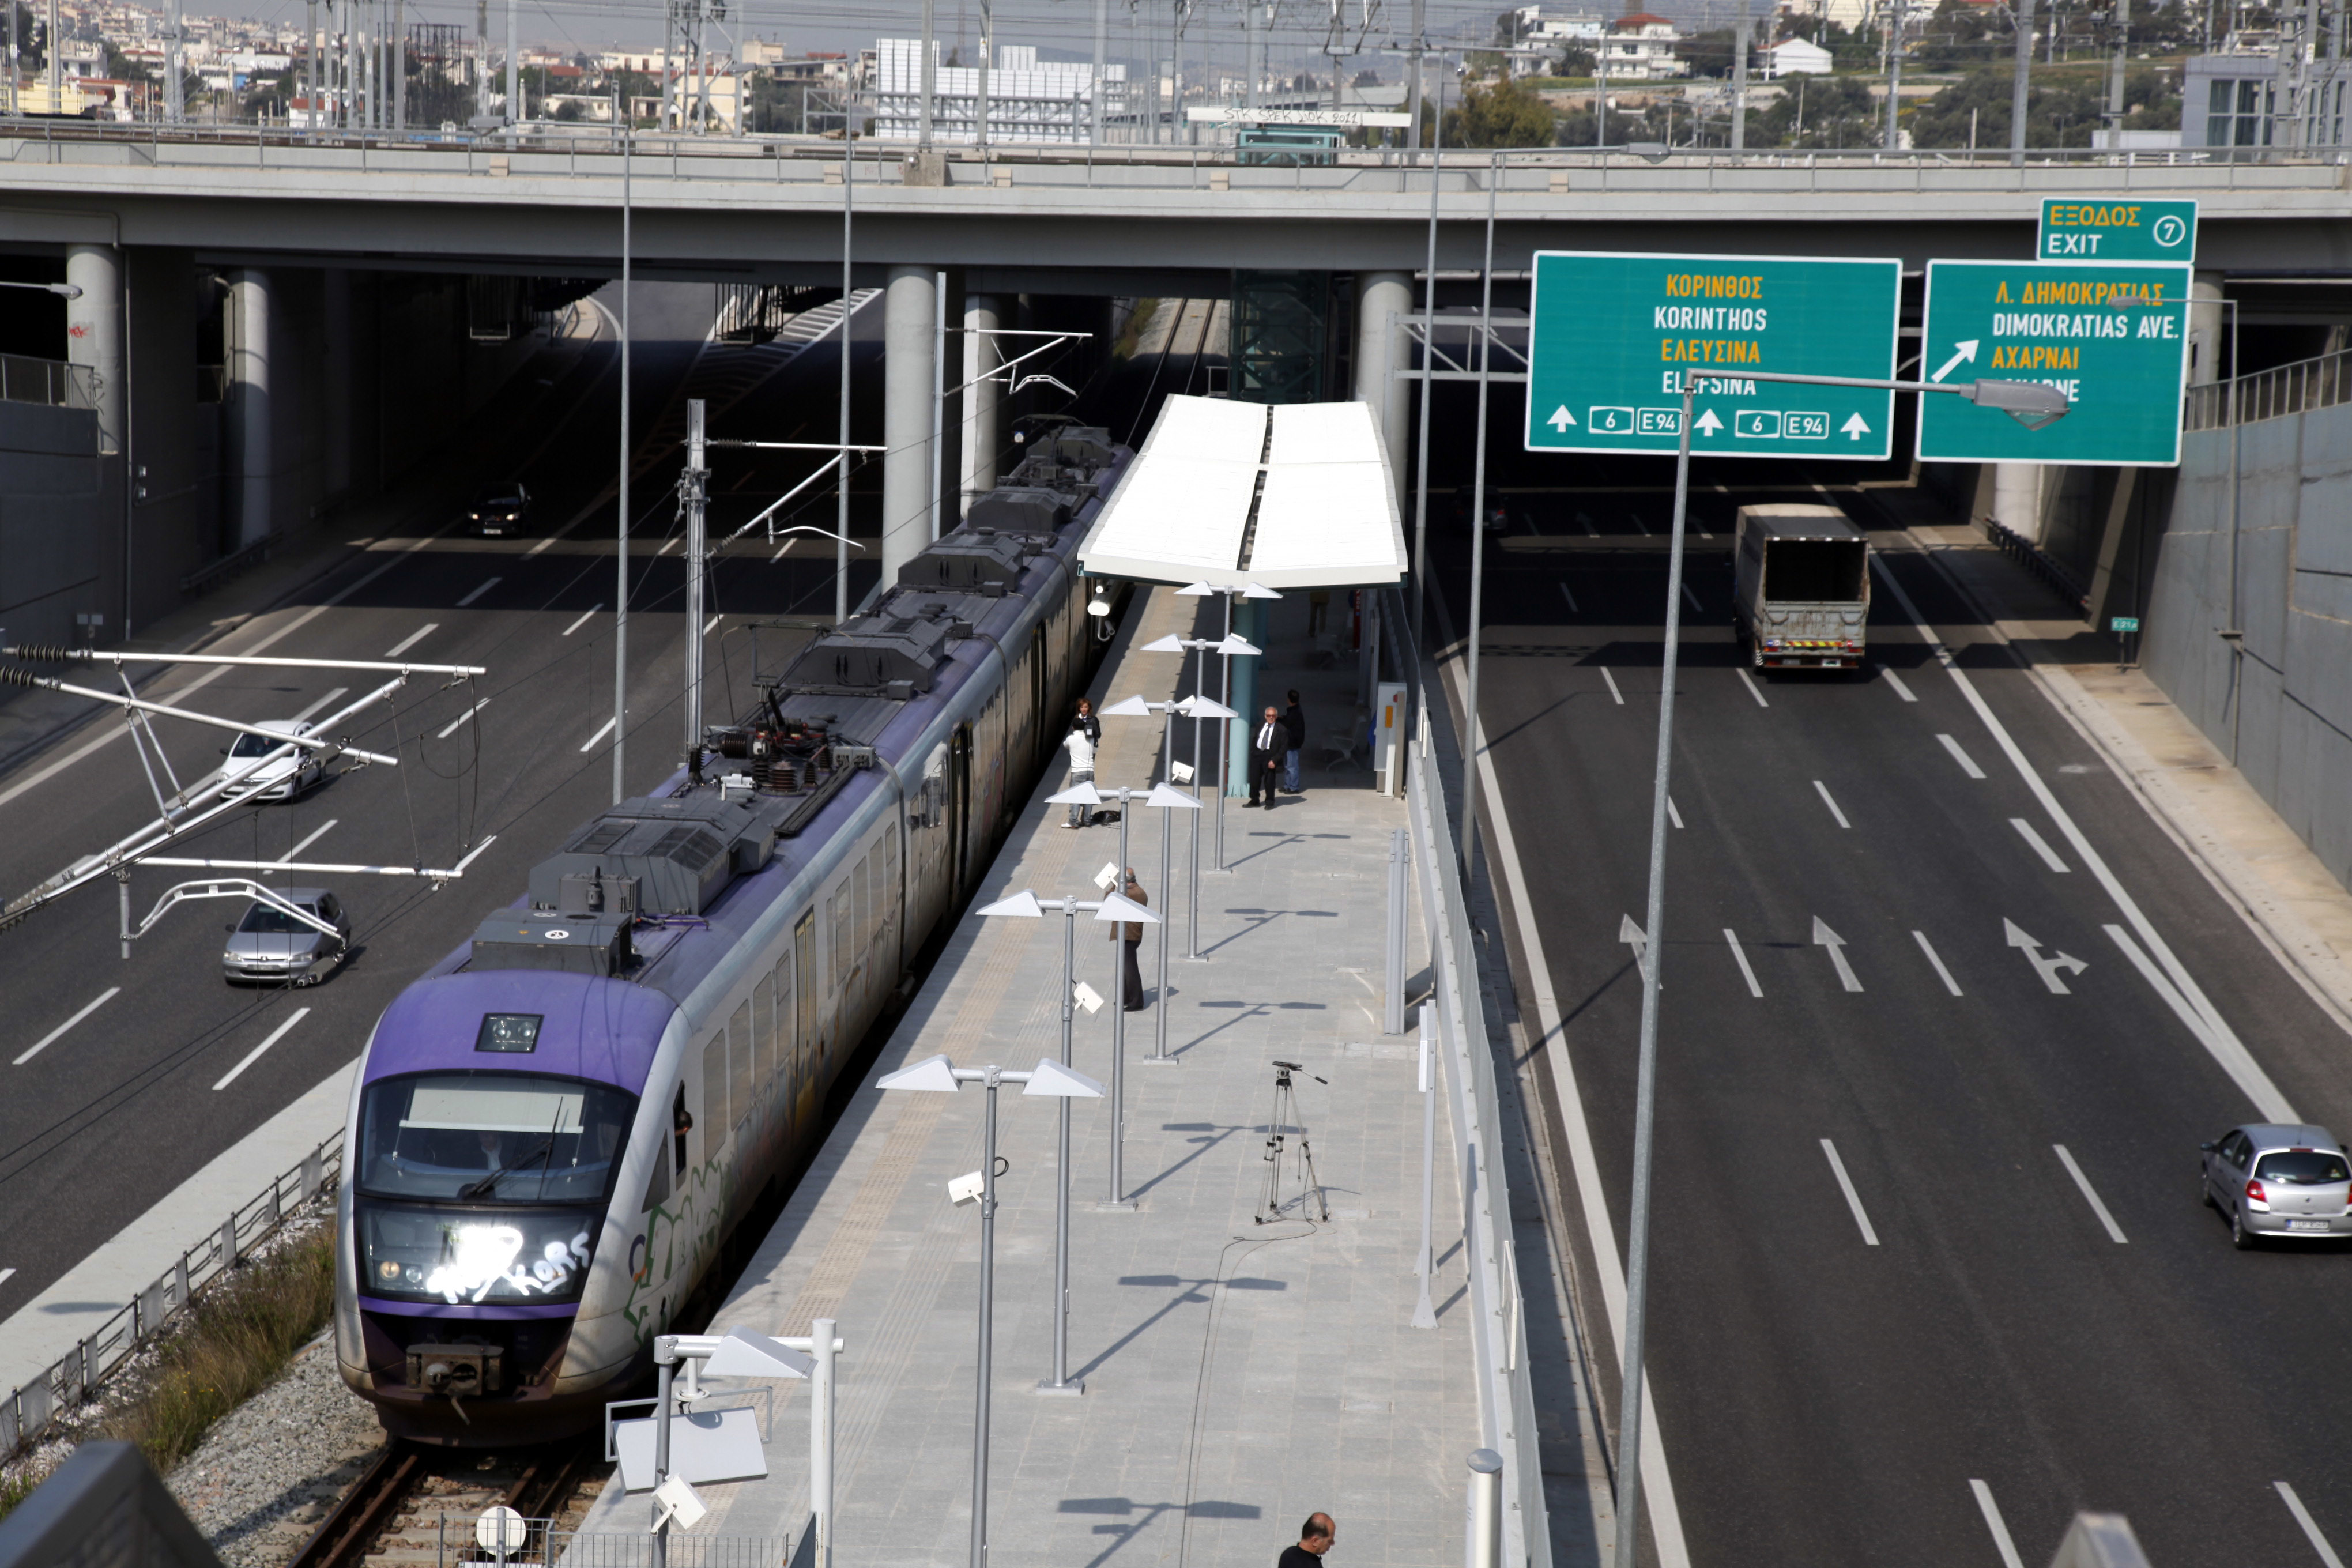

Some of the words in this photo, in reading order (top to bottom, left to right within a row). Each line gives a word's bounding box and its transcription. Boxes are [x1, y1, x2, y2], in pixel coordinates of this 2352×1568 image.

[2050, 205, 2141, 227] ΕΞΟΔΟΣ
[2163, 223, 2176, 240] 7
[2048, 233, 2102, 254] EXIT
[1667, 274, 1763, 299] ΚΟΡΙΝΘΟΣ
[1995, 281, 2014, 304] Λ.
[1654, 306, 1767, 331] KORINTHOS
[1992, 312, 2128, 338] DIMOKRATIAS
[2136, 315, 2180, 339] AVE.
[1661, 339, 1761, 363] ΕΛΕΥΣΙΝΑ
[1991, 346, 2079, 370] ΑΧΑΡΝΑΙ
[1662, 371, 1757, 395] ELFSINA
[1605, 412, 1616, 428] 6
[1752, 416, 1763, 432] 6
